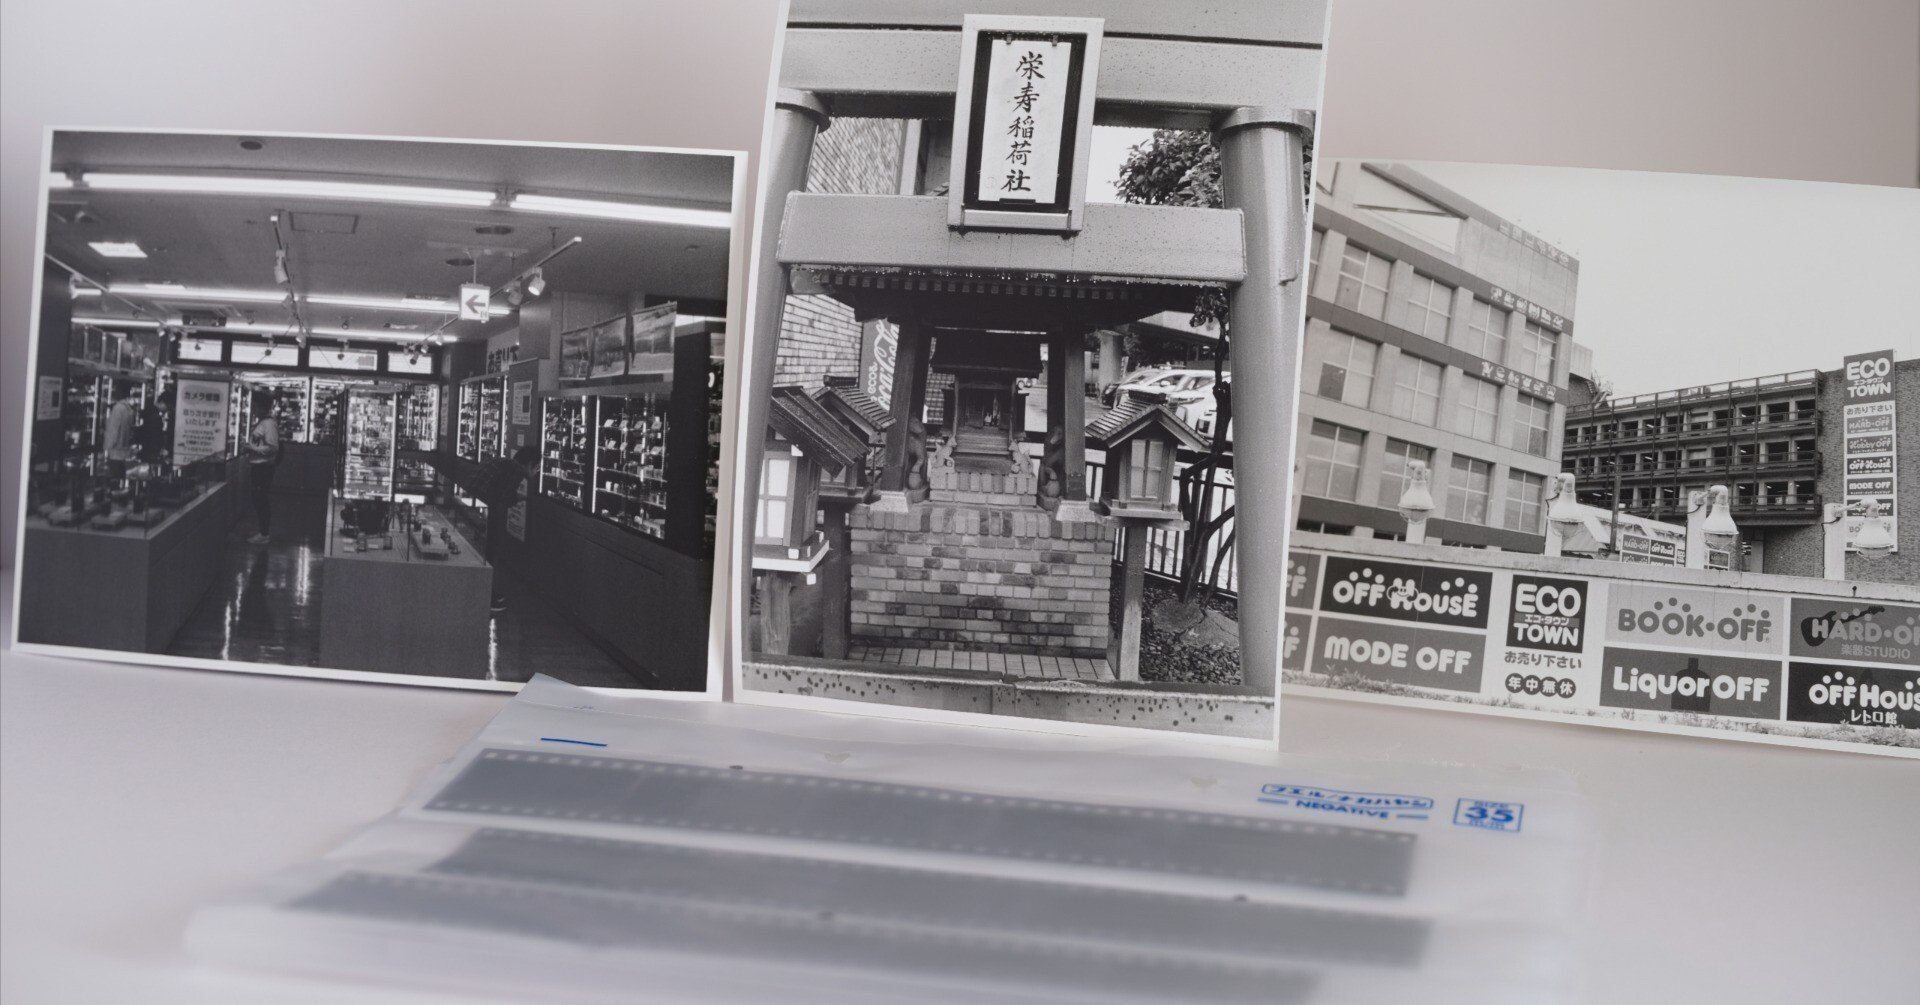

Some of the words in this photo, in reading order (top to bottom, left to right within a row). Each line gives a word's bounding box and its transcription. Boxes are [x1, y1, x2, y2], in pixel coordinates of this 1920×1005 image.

[1001, 51, 1045, 191] 栄寿稲荷社
[1846, 357, 1891, 380] ECO
[1846, 382, 1892, 398] TOWN
[1846, 404, 1893, 415] お売り下さい
[1874, 481, 1891, 489] OFF
[1332, 580, 1386, 607] OFF
[1515, 583, 1581, 617] ECO
[1513, 622, 1579, 646] TOWN
[1323, 635, 1409, 668] MODE
[1415, 646, 1472, 674] OFF
[1504, 651, 1582, 669] お売り下さい
[1506, 674, 1575, 697] 年中無休
[1808, 683, 1858, 707] OFF
[1851, 709, 1897, 725] レトロ館
[1295, 799, 1390, 820] NEGATIVE
[1465, 806, 1514, 823] 35
